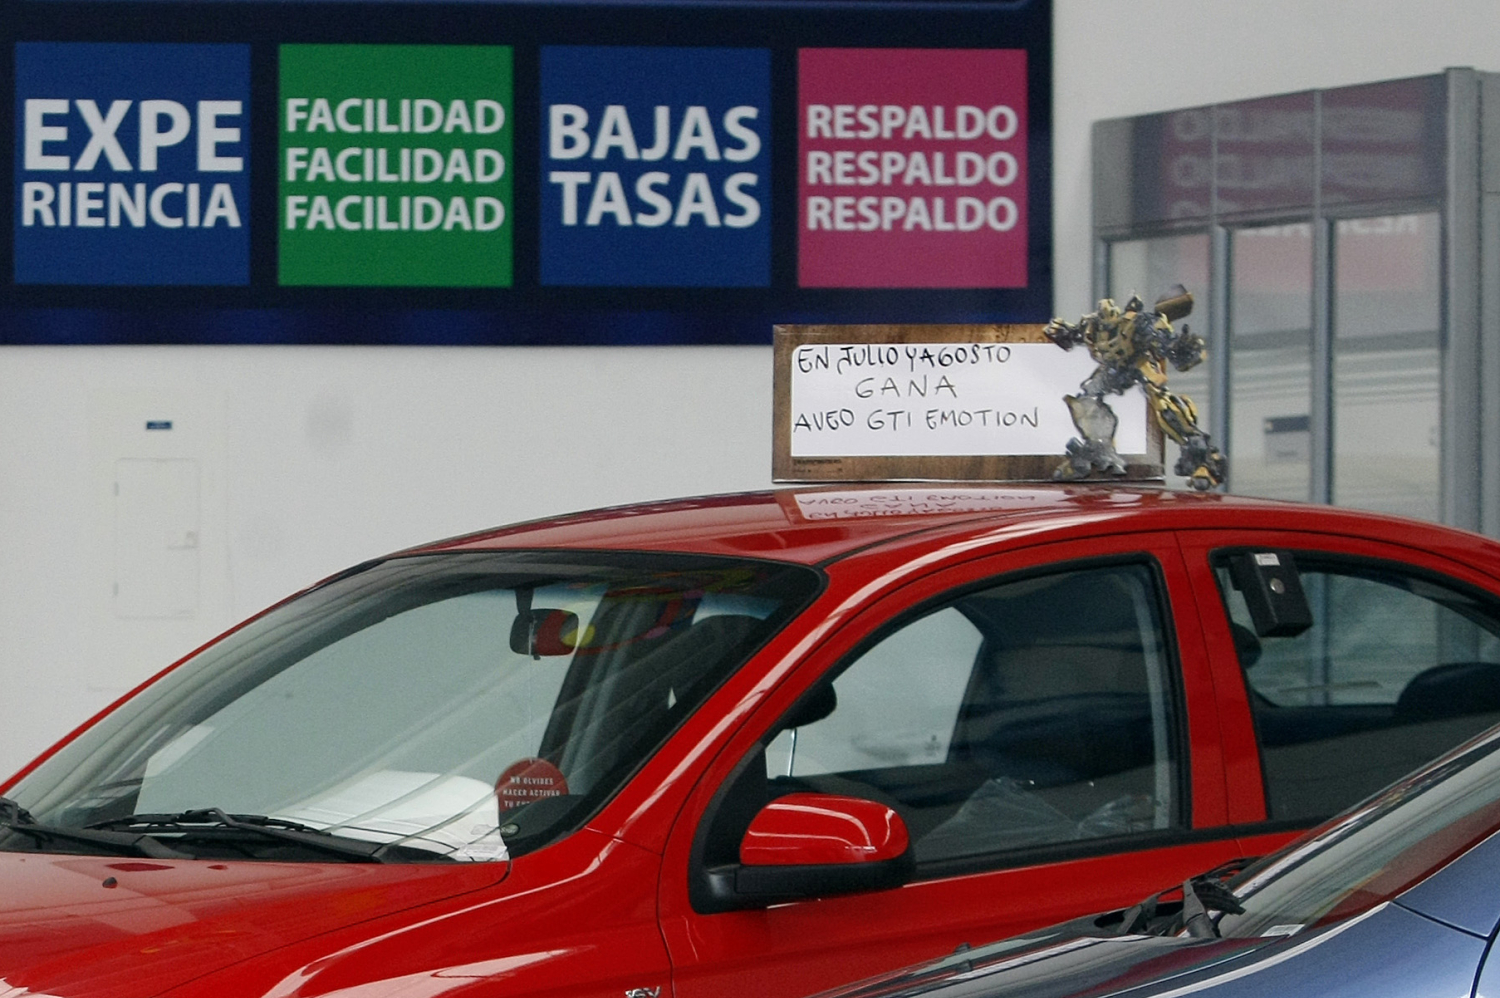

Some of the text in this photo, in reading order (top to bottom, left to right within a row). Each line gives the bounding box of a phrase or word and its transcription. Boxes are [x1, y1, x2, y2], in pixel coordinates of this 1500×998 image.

[287, 98, 505, 134] FACILIDAD
[550, 104, 760, 161] BAJAS
[807, 104, 1018, 140] RESPALDO
[24, 98, 243, 172] EXPE
[287, 147, 505, 183] FACILIDAD
[807, 151, 1018, 186] RESPALDO
[23, 181, 241, 228] RIENCIA
[286, 195, 505, 231] FACILIDAD
[550, 171, 760, 227] TASAS
[807, 196, 1018, 232] RESPALDO
[797, 346, 829, 373] EN
[855, 374, 957, 398] GANA
[793, 407, 1038, 433] AVEO GTI EMOTION
